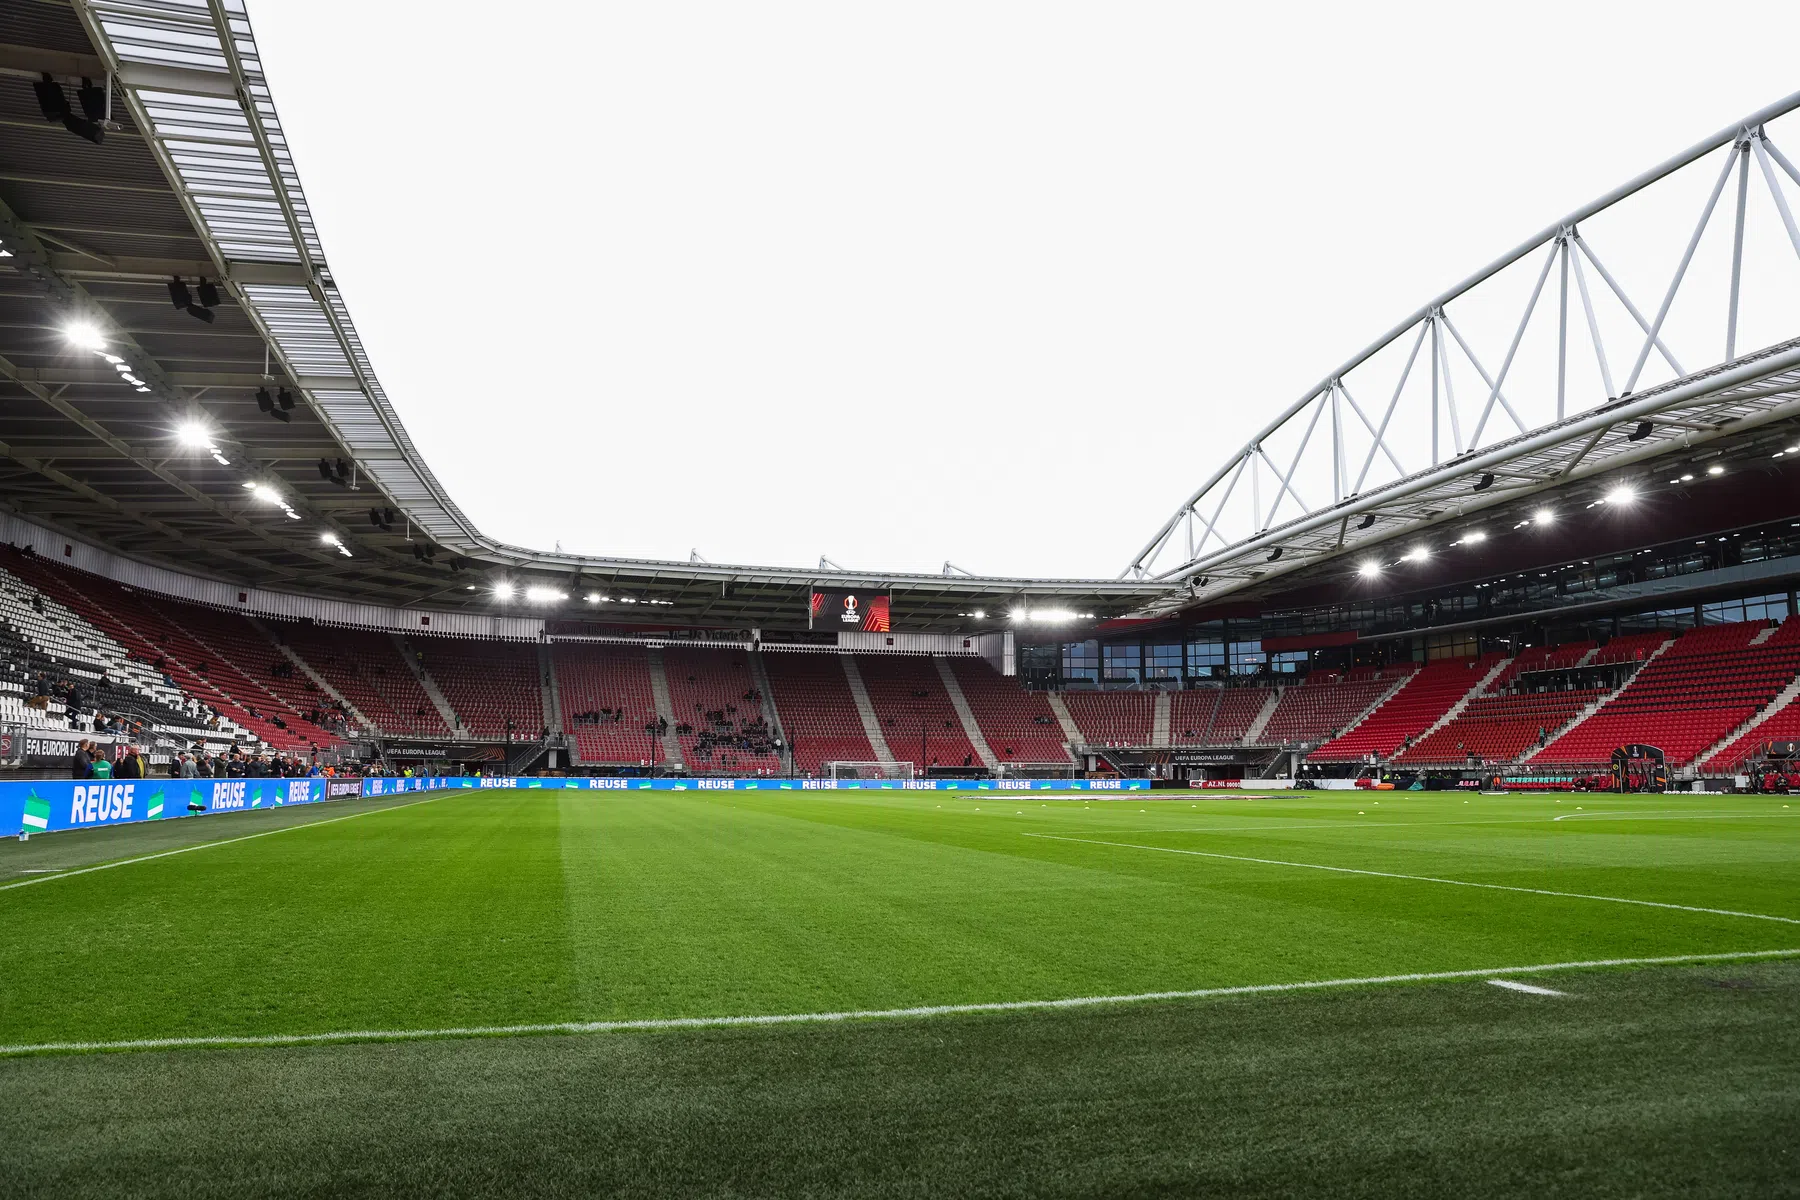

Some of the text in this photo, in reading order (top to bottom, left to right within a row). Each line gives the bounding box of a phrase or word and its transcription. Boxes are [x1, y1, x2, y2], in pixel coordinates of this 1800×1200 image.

[19, 738, 41, 755] EFA
[41, 740, 70, 757] EUROPA
[402, 748, 425, 756] EUROPA
[480, 779, 517, 788] REUSE
[589, 779, 628, 789] REUSE
[698, 780, 735, 789] REUSE
[802, 780, 838, 790] REUSE
[902, 781, 937, 790] REUSE
[998, 781, 1031, 790] REUSE
[1089, 780, 1121, 789] REUSE
[212, 781, 245, 809] REUSE
[288, 780, 310, 802] REUSE
[70, 784, 135, 824] REUSE
